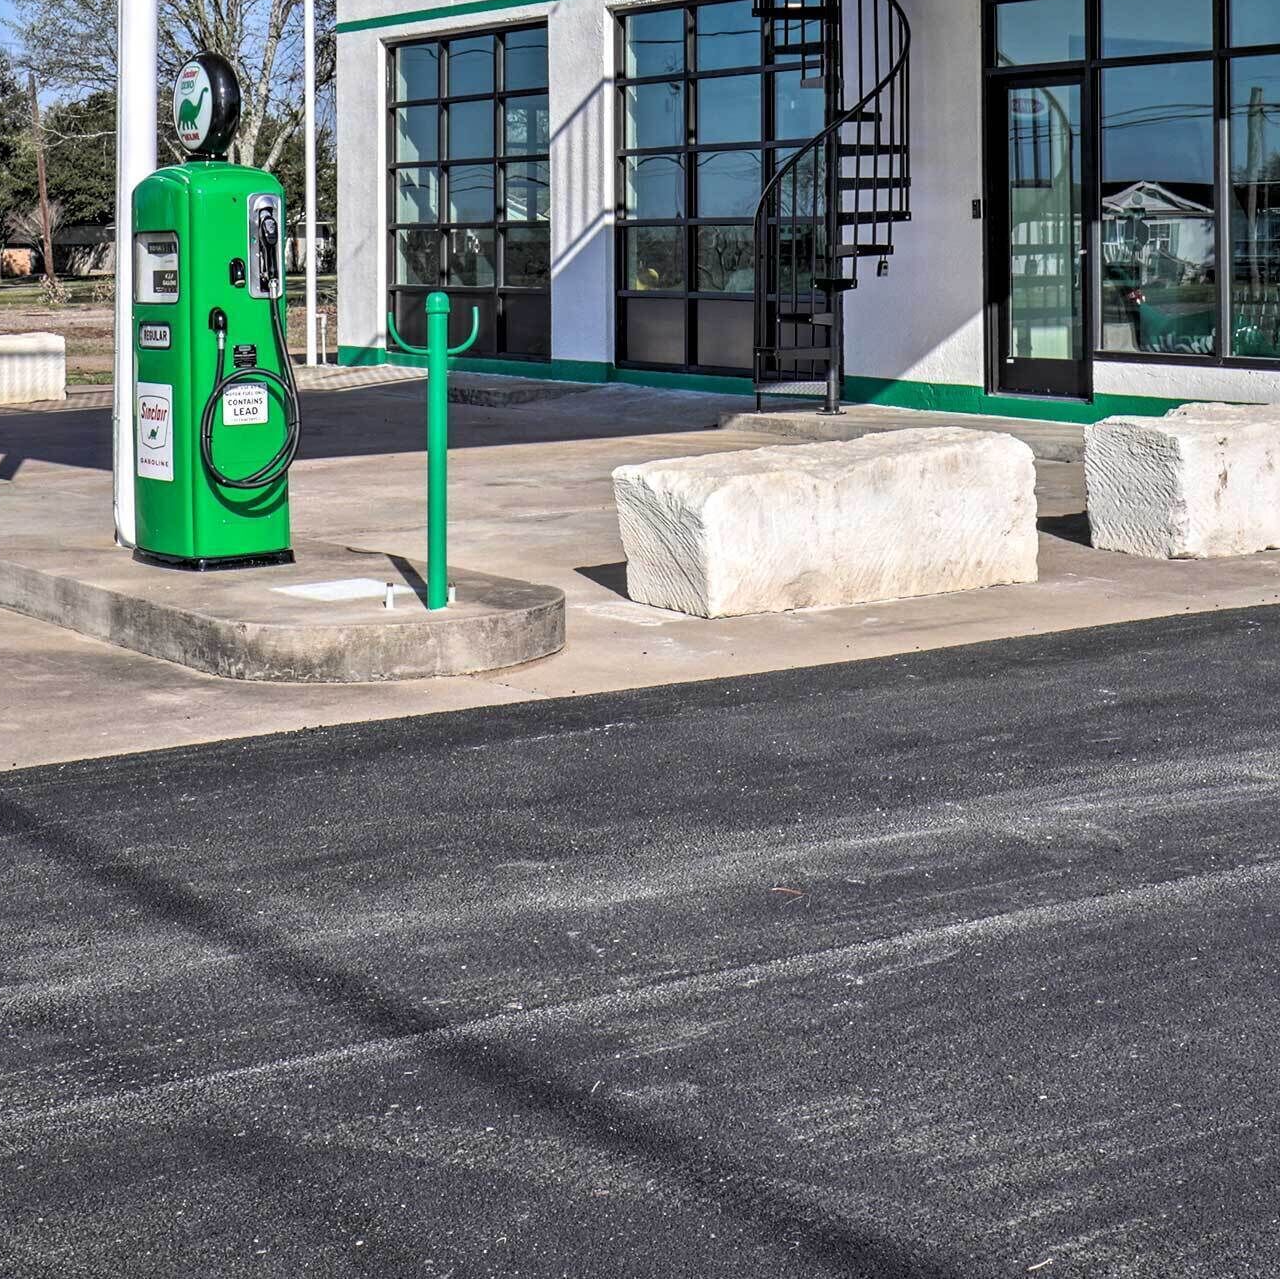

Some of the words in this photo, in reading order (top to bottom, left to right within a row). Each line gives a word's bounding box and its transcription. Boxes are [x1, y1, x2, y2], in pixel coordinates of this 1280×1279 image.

[143, 330, 167, 342] REGULAR
[228, 398, 263, 406] CONTAINS
[141, 401, 168, 422] Sinclair
[233, 407, 259, 417] LEAD
[140, 457, 169, 468] GASOLINE
